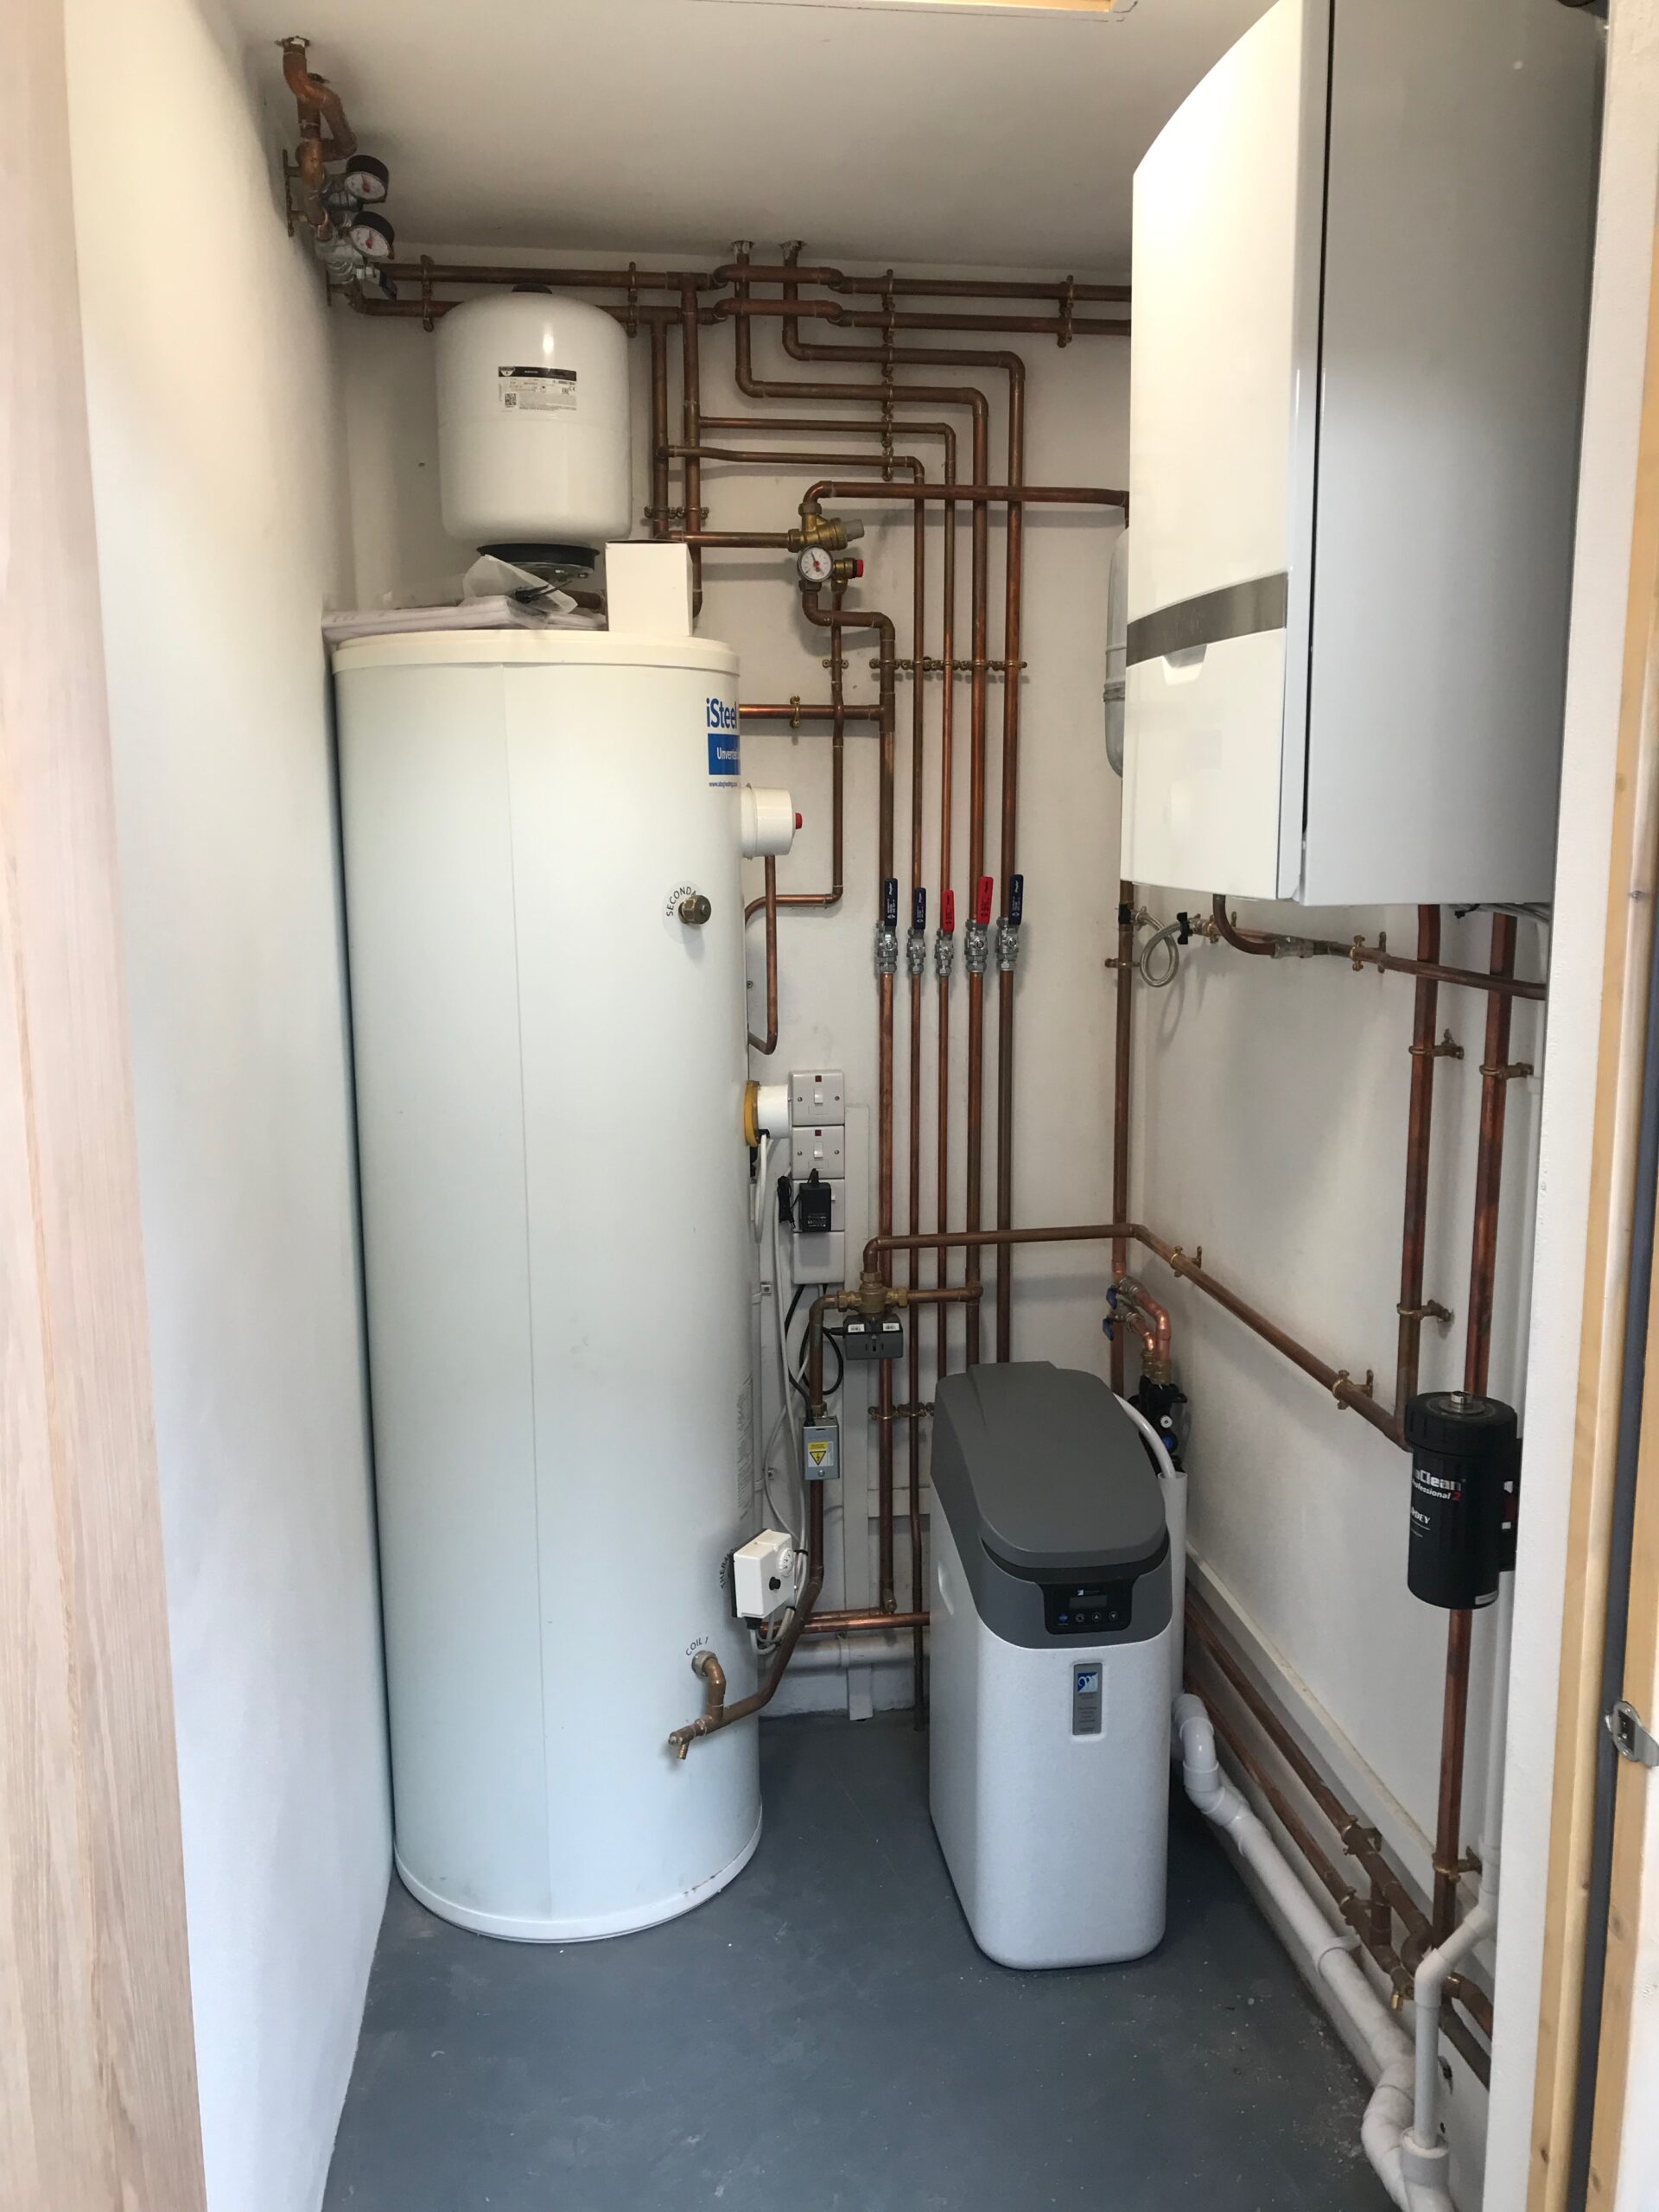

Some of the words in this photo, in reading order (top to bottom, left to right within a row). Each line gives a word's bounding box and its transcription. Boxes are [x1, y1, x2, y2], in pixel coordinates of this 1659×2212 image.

[706, 697, 737, 729] iSteel
[665, 886, 696, 917] SECONDA
[1414, 1469, 1462, 1492] aClean
[1452, 1491, 1462, 1501] 2
[685, 1637, 703, 1656] COIL
